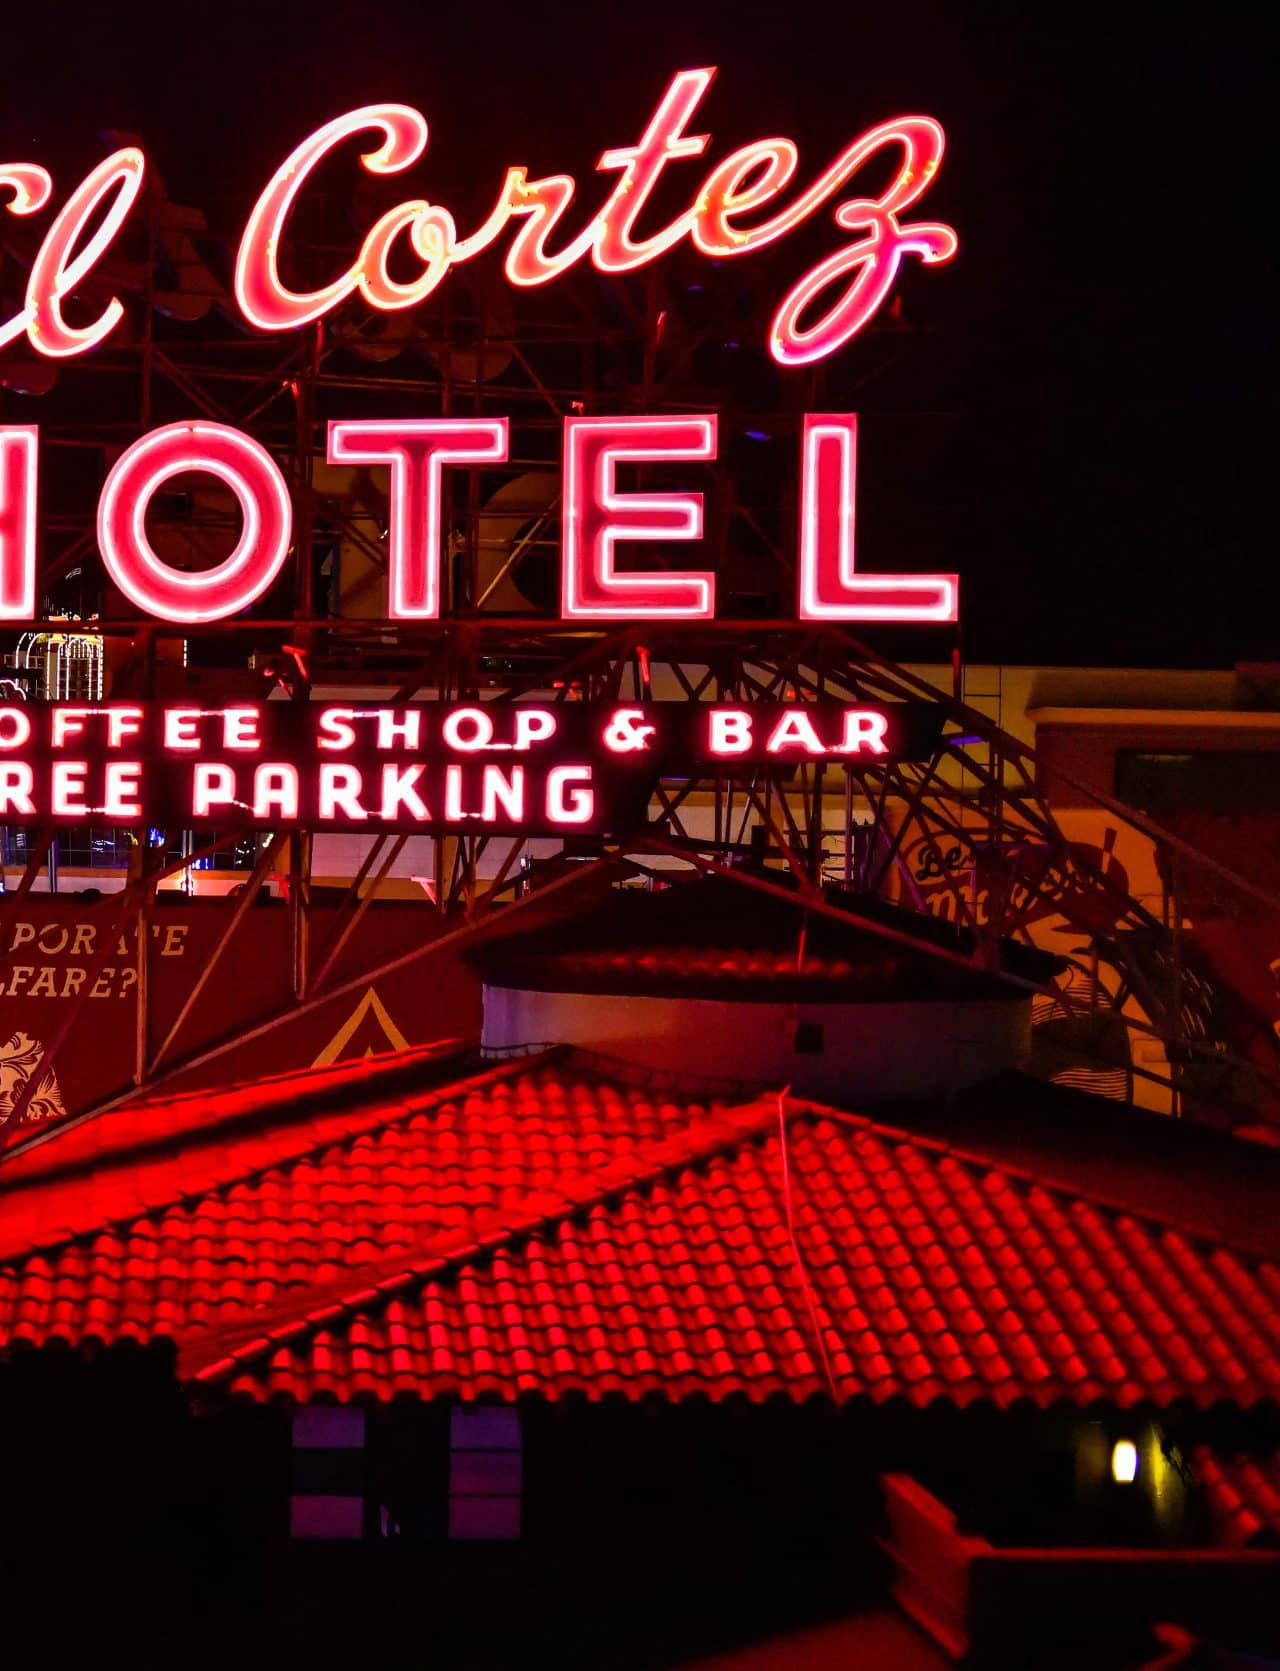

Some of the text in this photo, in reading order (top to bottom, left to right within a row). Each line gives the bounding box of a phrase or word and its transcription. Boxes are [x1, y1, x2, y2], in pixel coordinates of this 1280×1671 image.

[235, 66, 958, 366] Cortez
[318, 707, 557, 752] SHOP
[604, 709, 657, 753] &
[709, 709, 889, 754] BAR
[192, 764, 595, 823] PARKING
